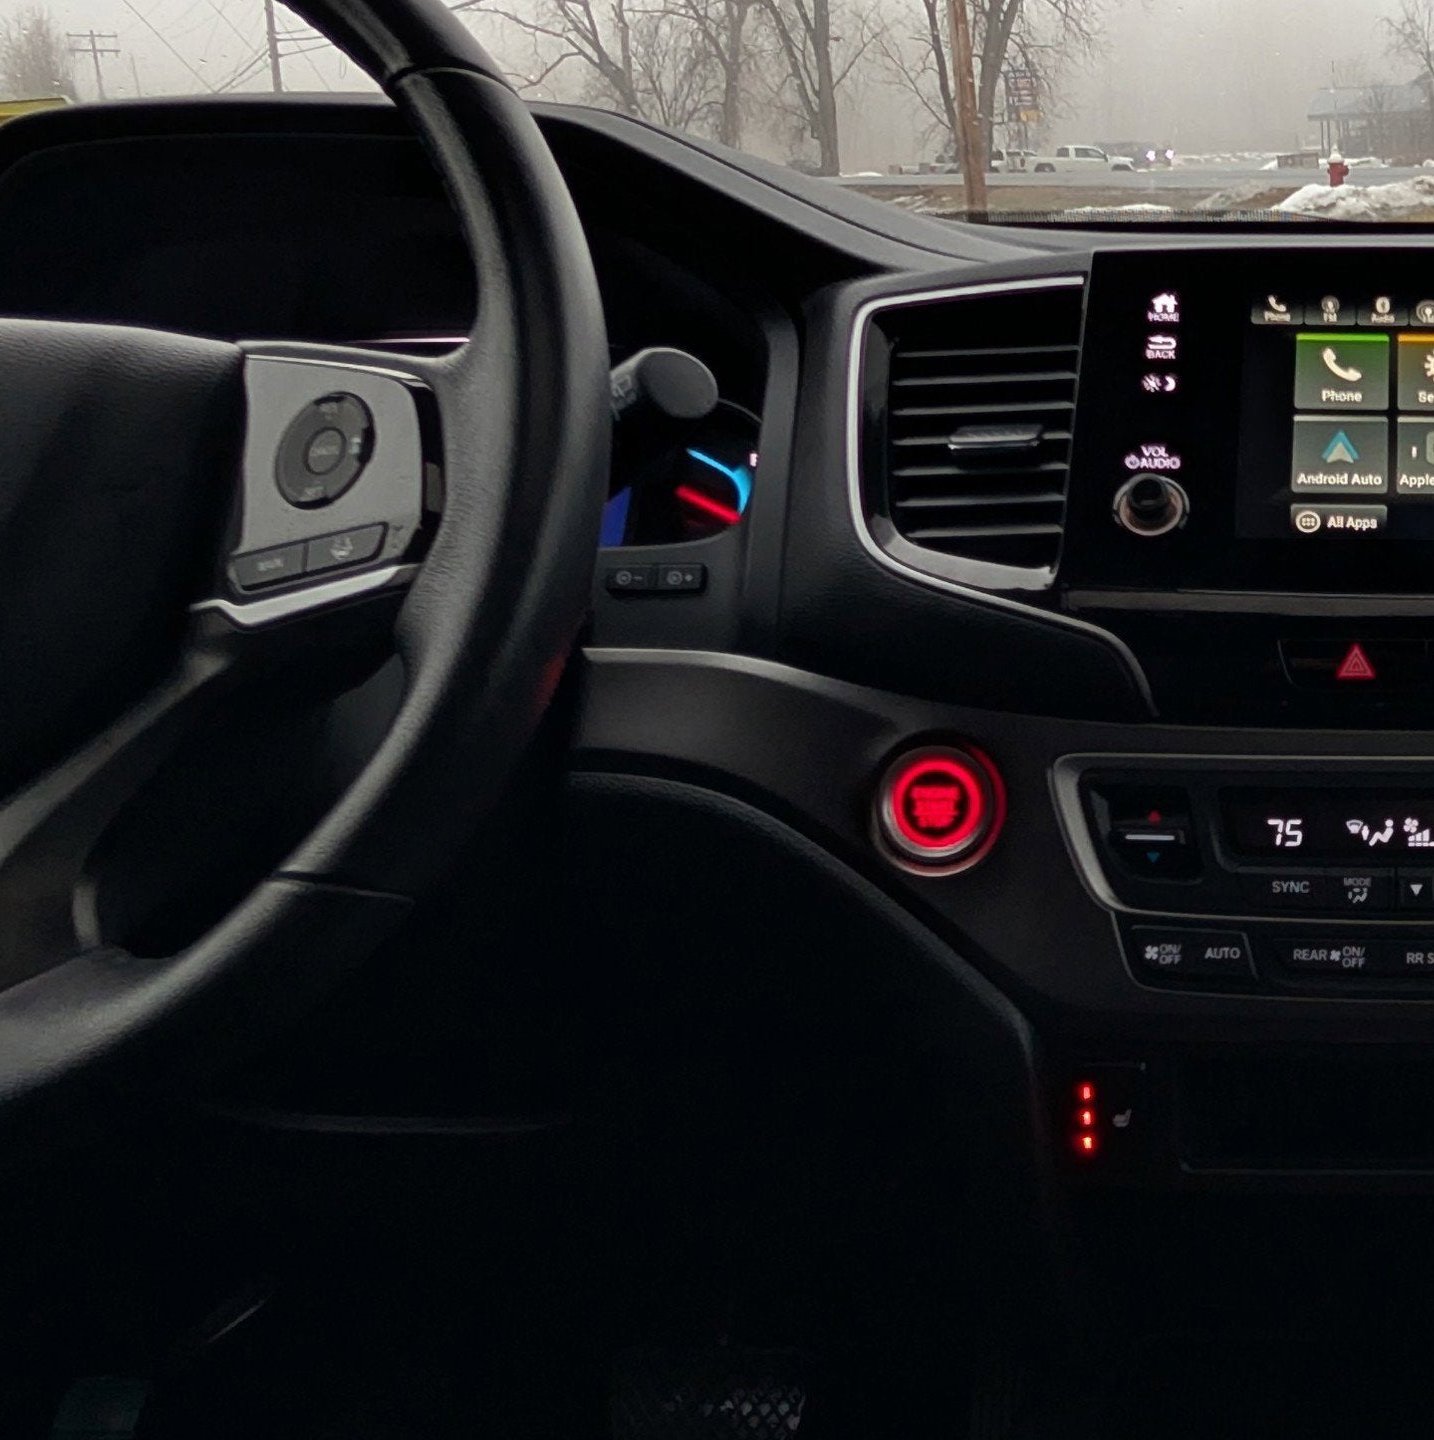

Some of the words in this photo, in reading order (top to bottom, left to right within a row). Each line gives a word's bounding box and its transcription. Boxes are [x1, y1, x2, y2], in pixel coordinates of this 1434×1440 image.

[1147, 311, 1180, 322] HOME
[1145, 349, 1176, 360] BACK
[1321, 389, 1363, 402] Phone
[1140, 445, 1168, 457] VOL
[1139, 457, 1181, 470] AUDIO
[1297, 473, 1348, 485] Android
[1351, 473, 1383, 485] Auto
[1327, 516, 1344, 529] All
[1346, 517, 1378, 531] Apps
[1267, 818, 1304, 847] 75
[1271, 880, 1310, 895] SYNC
[1344, 877, 1372, 888] MODE
[1159, 943, 1183, 954] ON/
[1204, 947, 1242, 960] AUTO
[1292, 948, 1328, 961] REAR
[1341, 945, 1366, 956] ON/
[1159, 954, 1182, 966] OFF
[1341, 956, 1366, 969] OFF
[1406, 952, 1424, 964] RR
